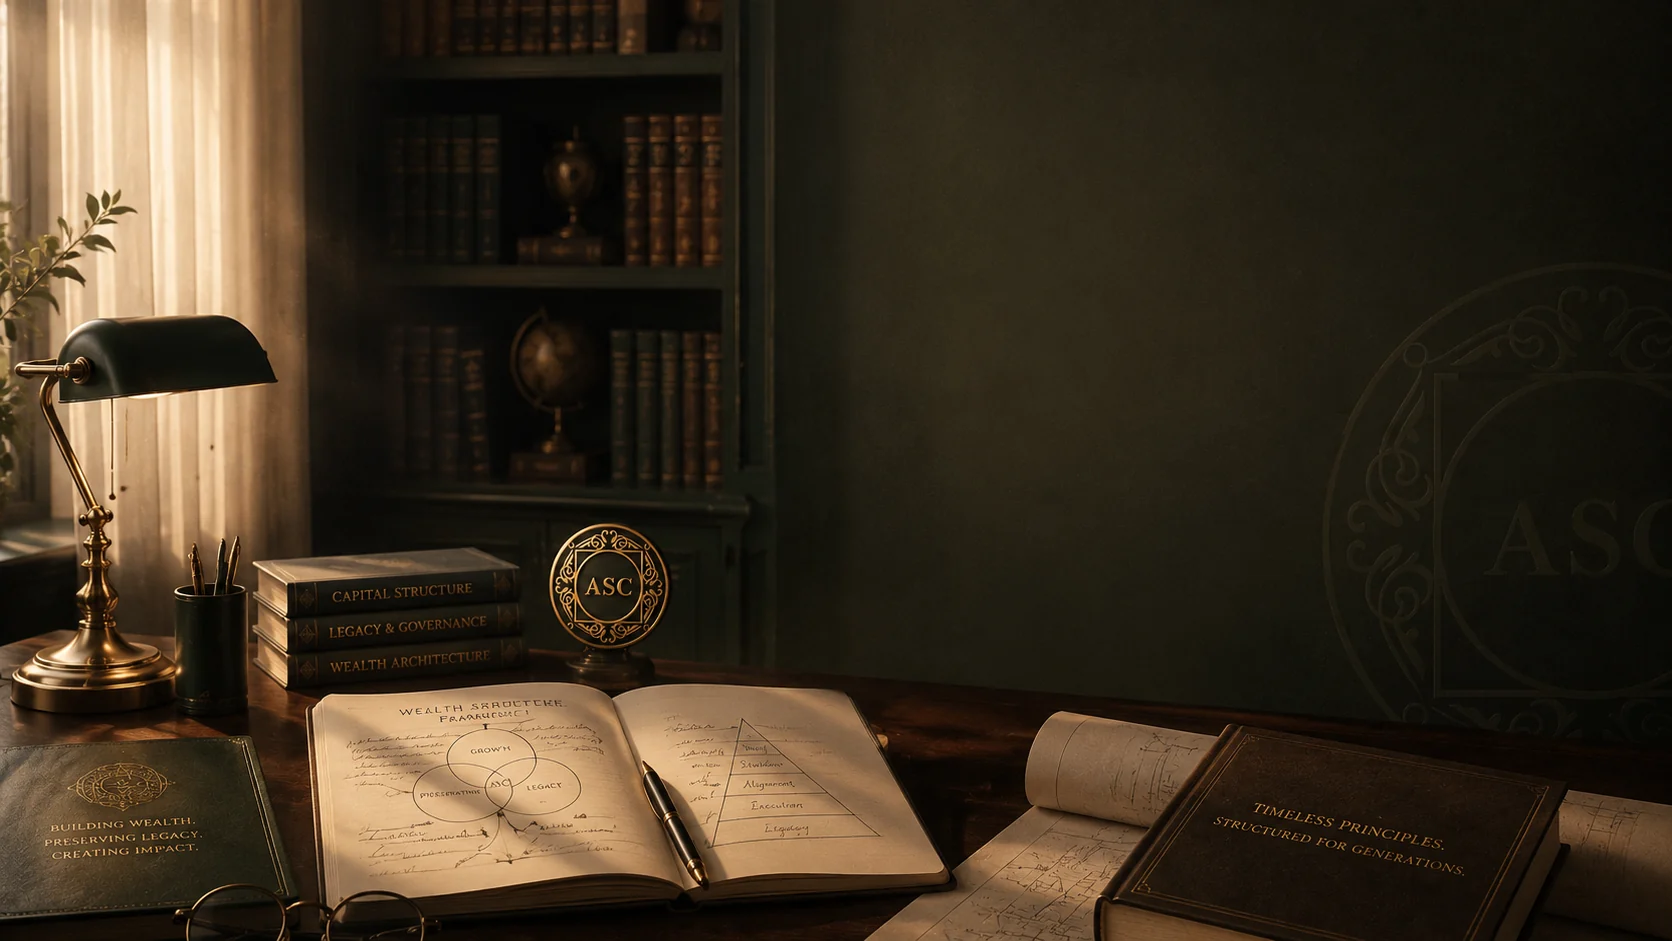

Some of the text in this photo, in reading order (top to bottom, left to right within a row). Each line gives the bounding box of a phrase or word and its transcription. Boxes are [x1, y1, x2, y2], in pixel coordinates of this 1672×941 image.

[332, 582, 473, 603] CAPITAL STRUCTURE
[584, 577, 633, 597] ASC
[329, 615, 487, 639] LEGACY & GOVERNANCE
[330, 649, 490, 673] WEALTH ARCHITECTURE
[399, 704, 463, 716] WEALTH
[50, 817, 196, 832] BUILDING WEALTH.
[1253, 802, 1445, 851] TIMELESS PRINCIPLES.
[44, 831, 203, 847] PRESERVING LEGACY.
[1213, 816, 1465, 876] STRUCTURED FOR GENERATIONS.
[51, 843, 199, 860] CREATING IMPACT.
